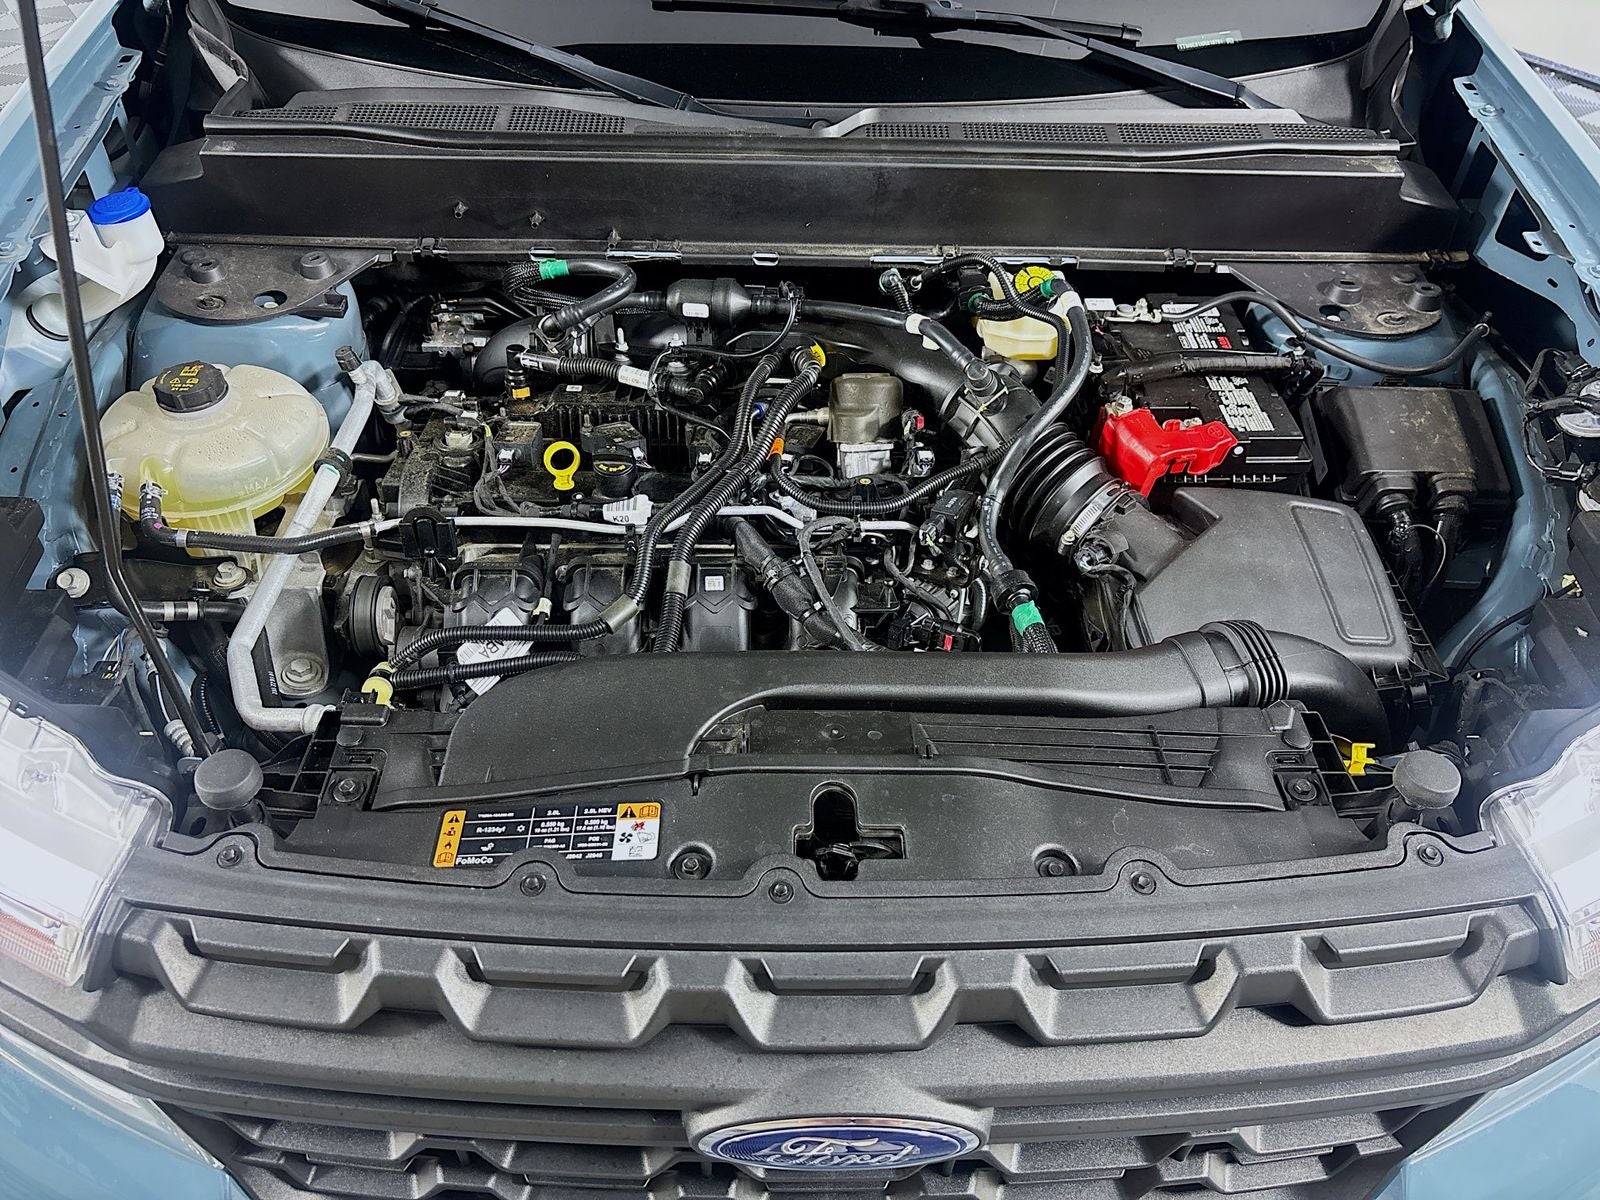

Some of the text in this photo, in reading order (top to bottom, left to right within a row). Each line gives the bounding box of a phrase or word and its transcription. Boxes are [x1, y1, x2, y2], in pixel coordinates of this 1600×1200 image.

[244, 477, 270, 494] MAX
[476, 825, 507, 834] R-1234yf
[455, 856, 494, 865] FoMoCo
[766, 1136, 921, 1165] Ford
